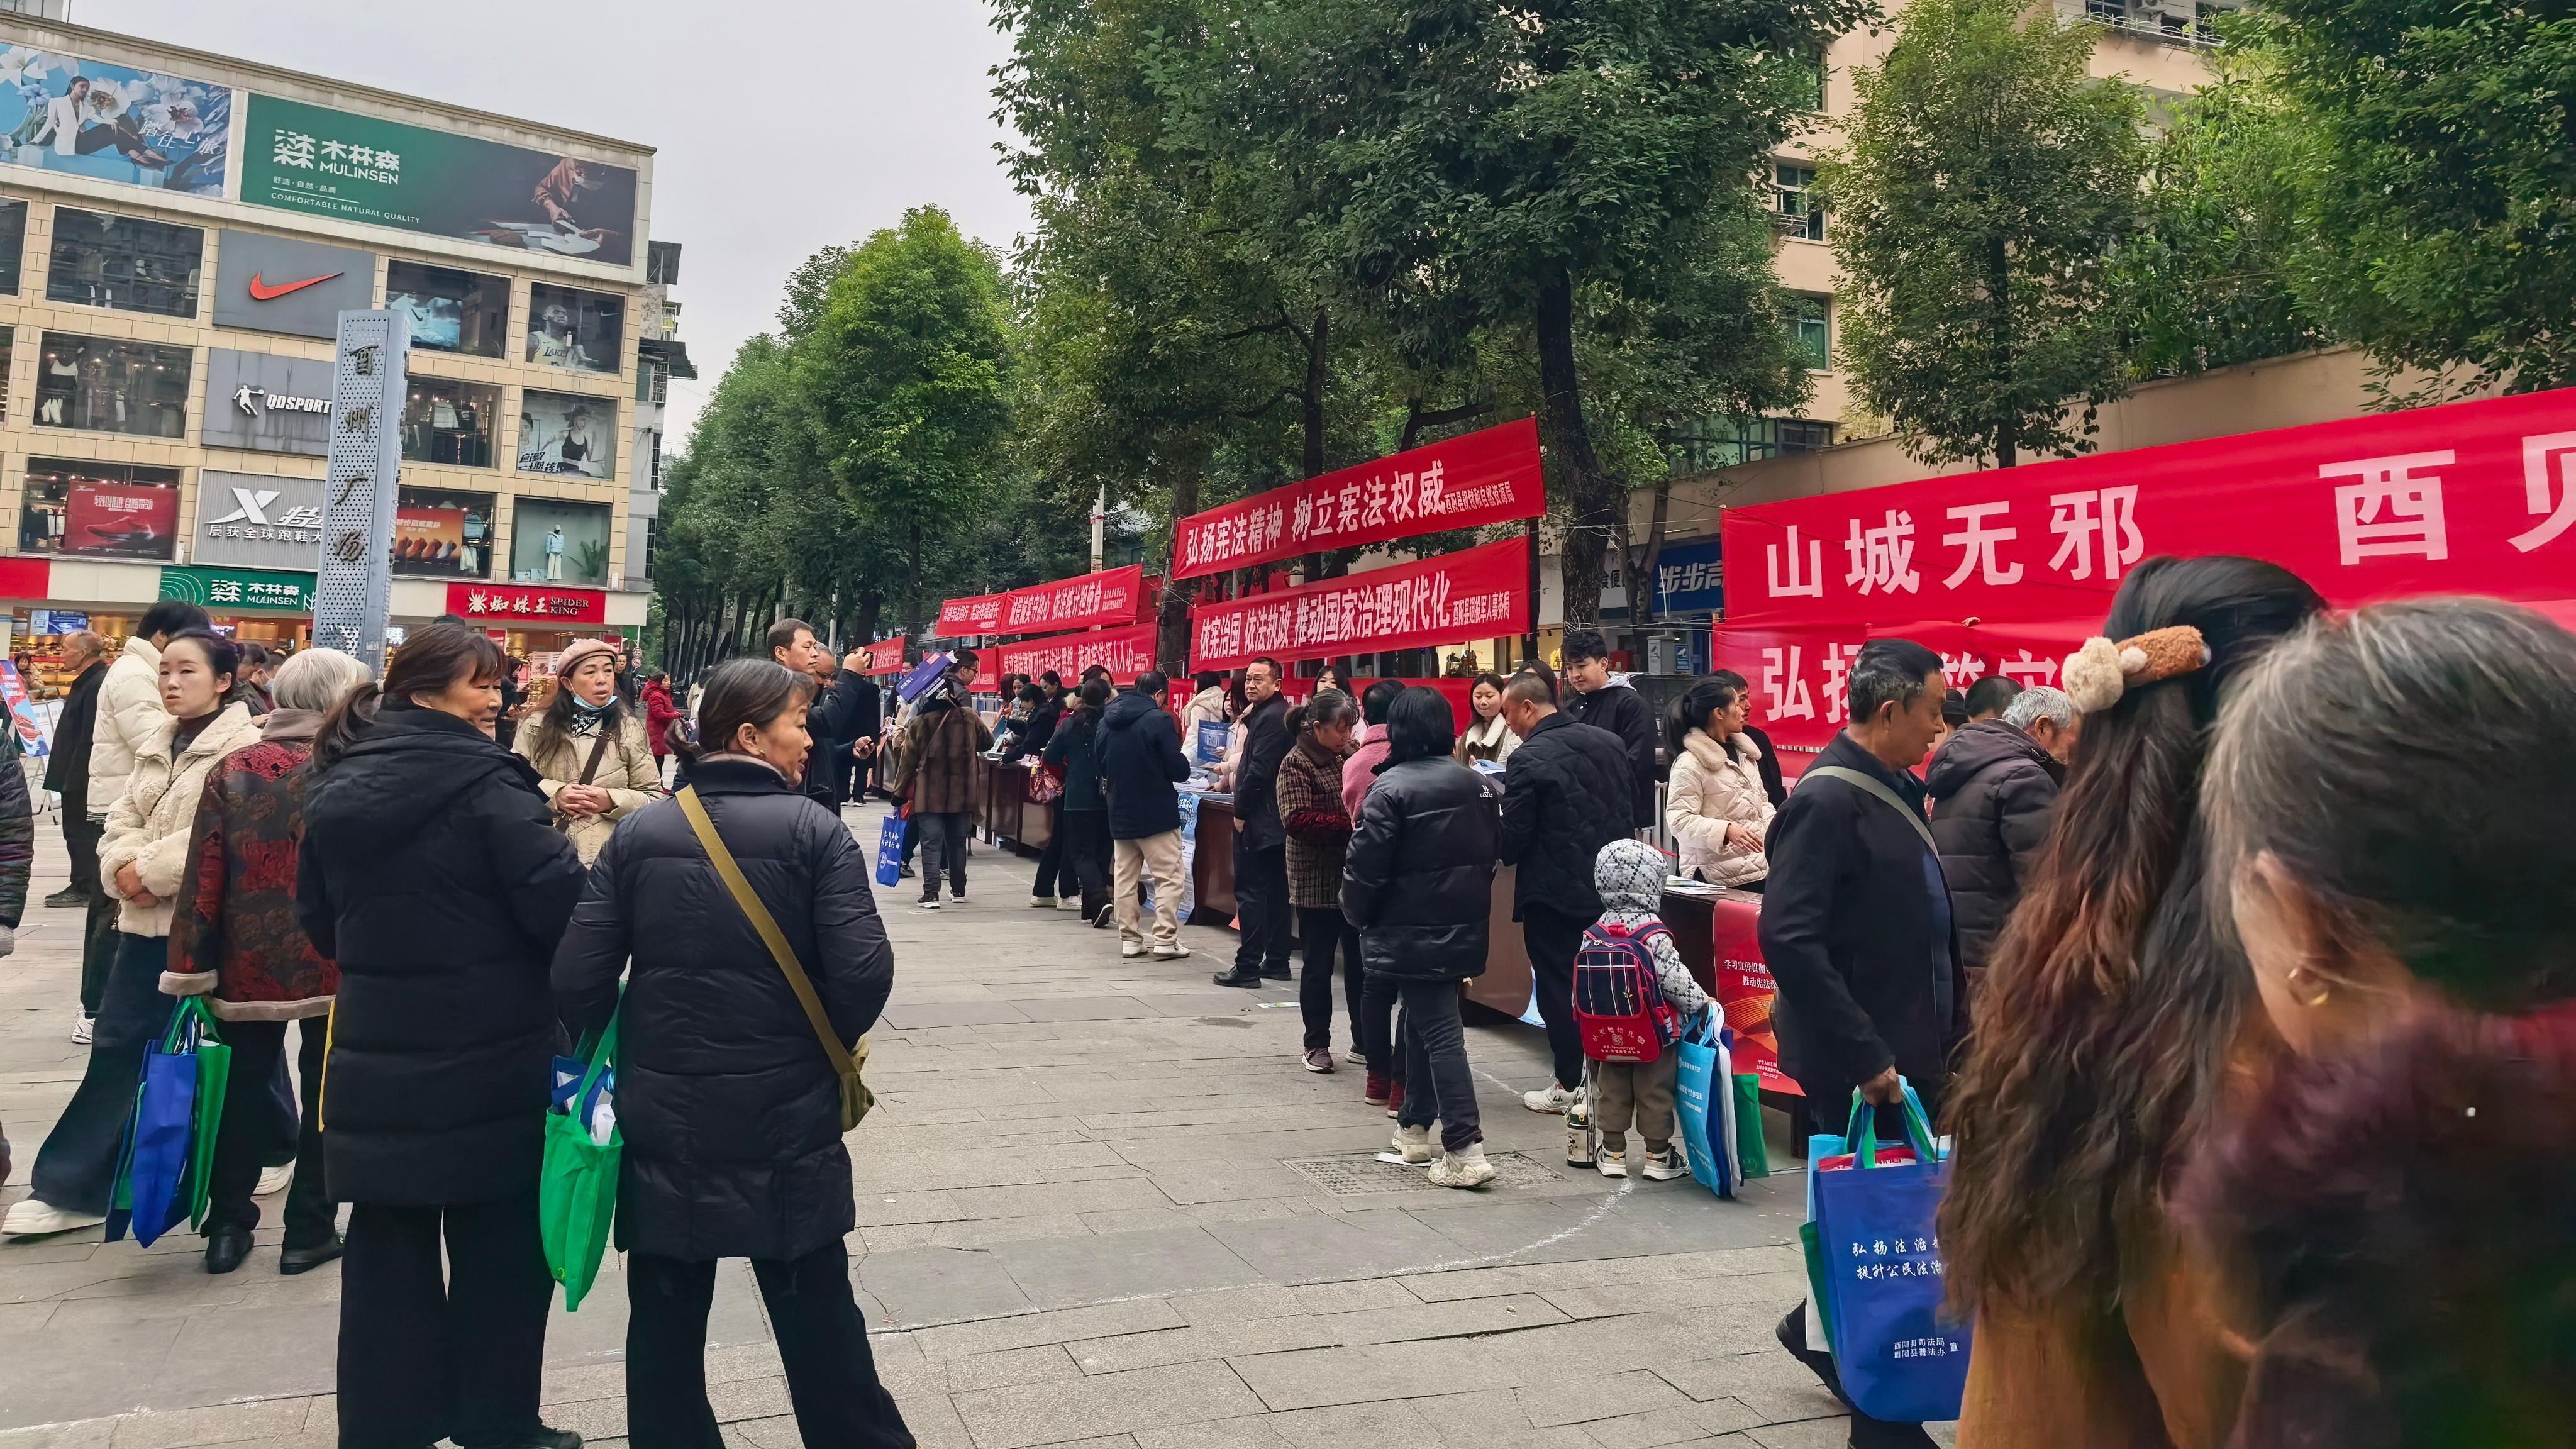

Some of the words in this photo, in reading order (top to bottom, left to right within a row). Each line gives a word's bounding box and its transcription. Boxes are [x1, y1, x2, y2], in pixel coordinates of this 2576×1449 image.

[321, 140, 400, 171] 木林森
[319, 160, 399, 185] MULINSEN
[271, 192, 338, 209] COMFORTABLE
[341, 204, 381, 217] NATURAL
[384, 211, 421, 224] QUALITY
[542, 345, 567, 357] LAKE
[265, 394, 333, 414] QDSPORT
[1186, 501, 1283, 567] 弘扬宪法精神
[1291, 460, 1446, 543] 树立宪法权威
[1767, 484, 2145, 598] 山城无邪
[248, 582, 300, 596] 木林森
[246, 595, 298, 606] MULINSEN
[489, 594, 547, 614] 蜘蛛王
[550, 597, 589, 608] SPIDER
[1453, 591, 1510, 628] 酉阳县退役军人事务局
[550, 606, 578, 616] KING
[1199, 611, 1242, 661] 依宪治国
[1244, 601, 1292, 655] 依法执政
[1294, 570, 1452, 647] 推动国家治理现代化
[1724, 959, 1769, 974] 学习宣传贯彻
